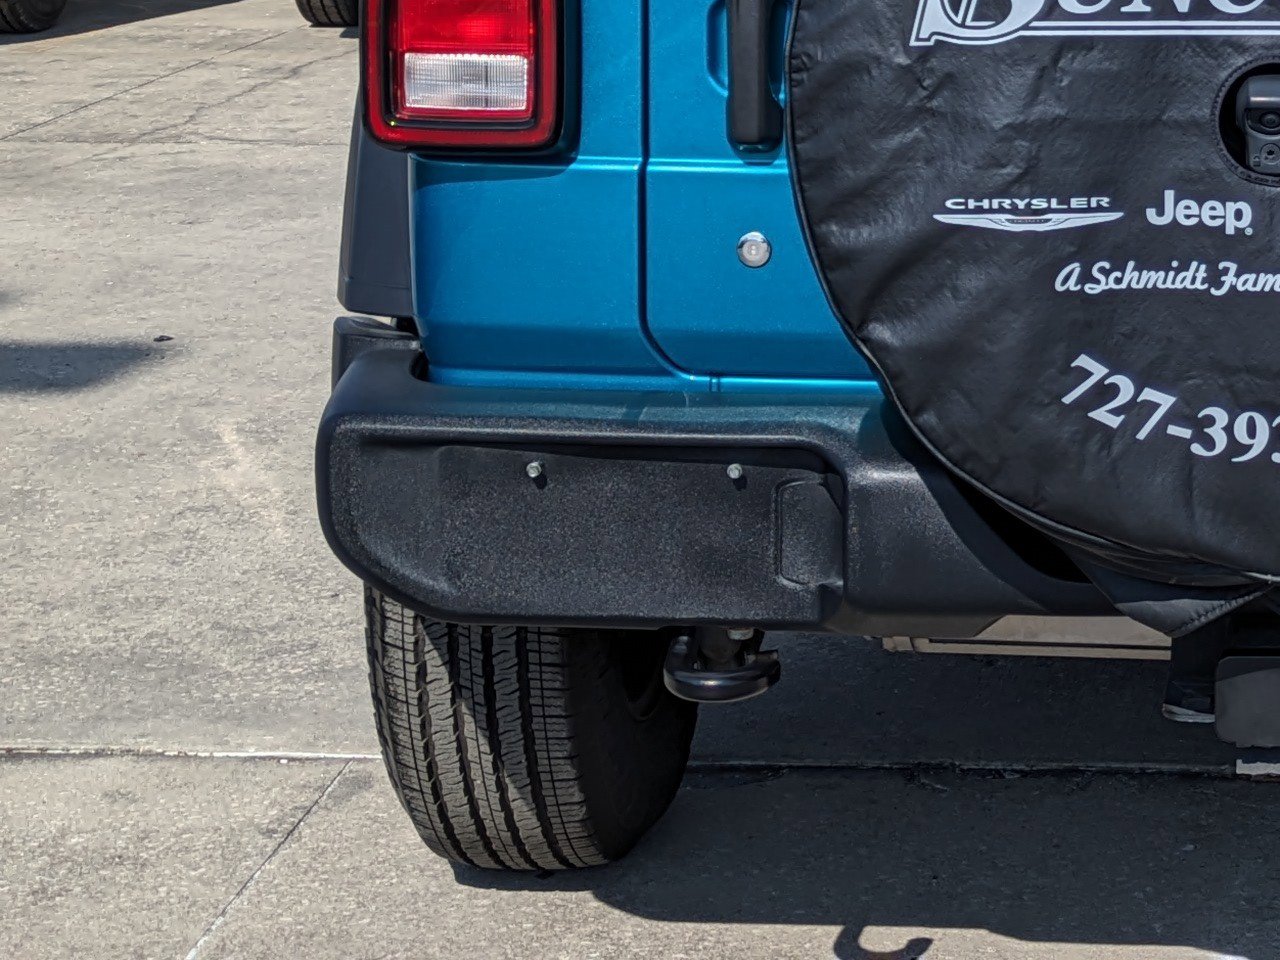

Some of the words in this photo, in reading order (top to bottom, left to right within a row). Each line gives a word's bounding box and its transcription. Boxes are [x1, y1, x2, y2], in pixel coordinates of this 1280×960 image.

[944, 196, 1111, 210] CHRYSLER
[1146, 190, 1253, 235] Jeep
[1054, 261, 1082, 292] A
[1083, 260, 1209, 295] Schmidt
